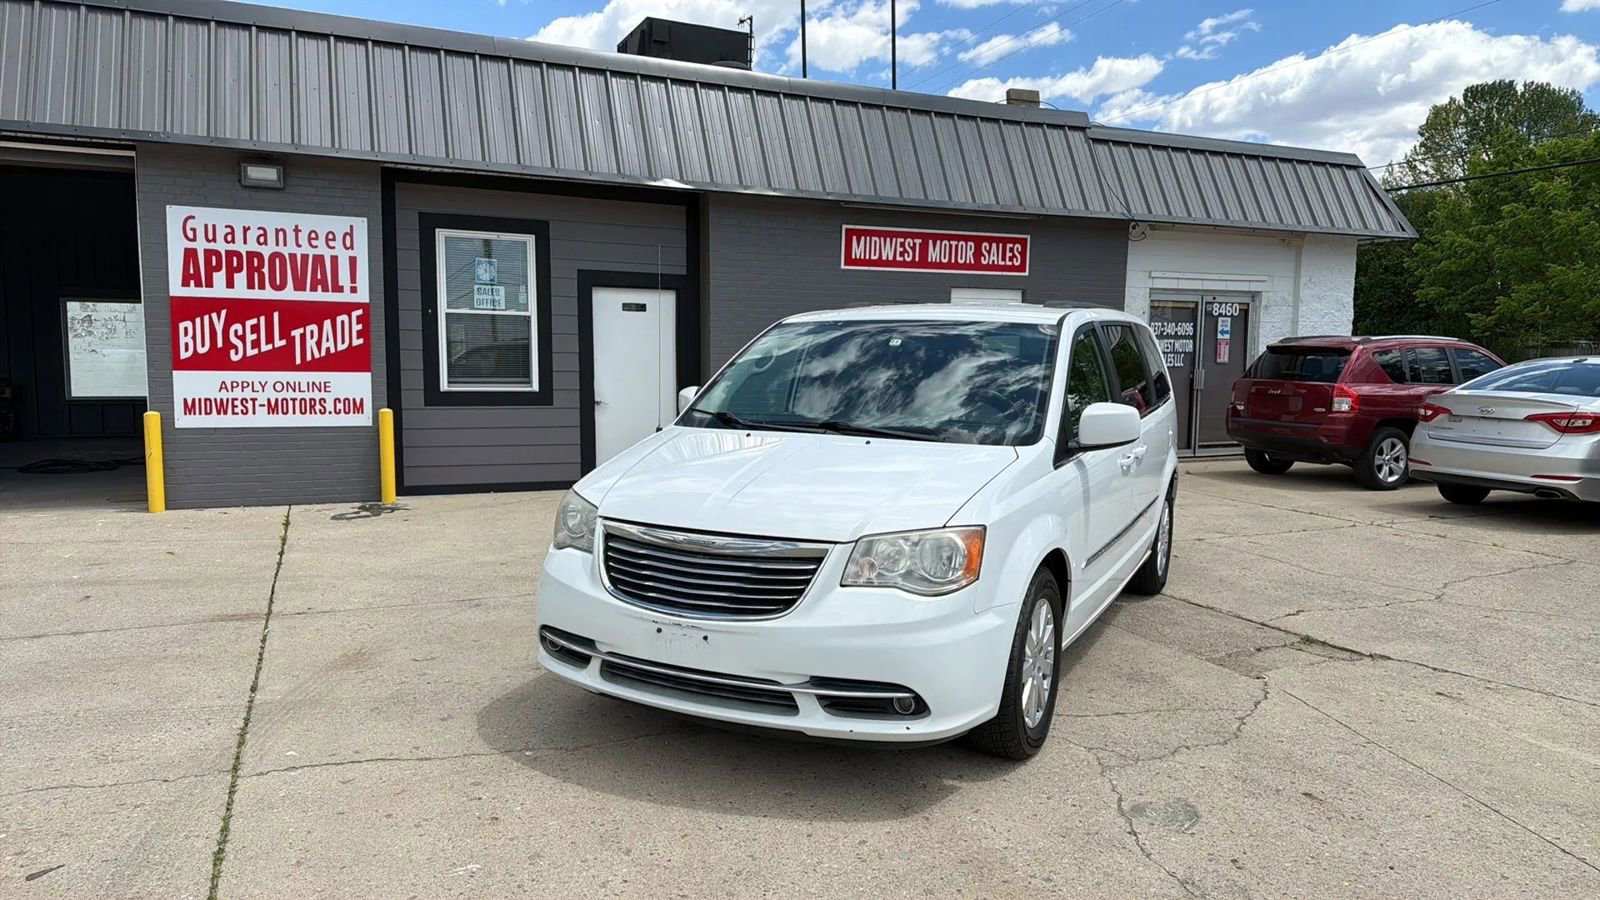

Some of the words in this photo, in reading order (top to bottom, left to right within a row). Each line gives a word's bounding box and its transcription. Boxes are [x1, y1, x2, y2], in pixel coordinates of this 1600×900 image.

[181, 215, 354, 250] Guaranteed
[851, 235, 922, 262] MIDWEST
[927, 239, 975, 265] MOTOR
[980, 241, 1022, 266] SALES
[181, 247, 358, 294] APPROVAL!
[477, 287, 500, 297] SALES
[476, 298, 501, 308] OFFICE
[1212, 303, 1240, 316] 8460
[178, 308, 227, 360] BUY
[229, 310, 287, 362] SELL
[290, 308, 364, 366] TRADE
[1159, 339, 1174, 352] WEST
[1174, 339, 1194, 353] MOTOR
[1174, 353, 1184, 367] LLC
[218, 380, 268, 393] APPLY
[272, 380, 332, 393] ONLINE
[183, 397, 365, 416] MIDWEST-MOTORS.COM
